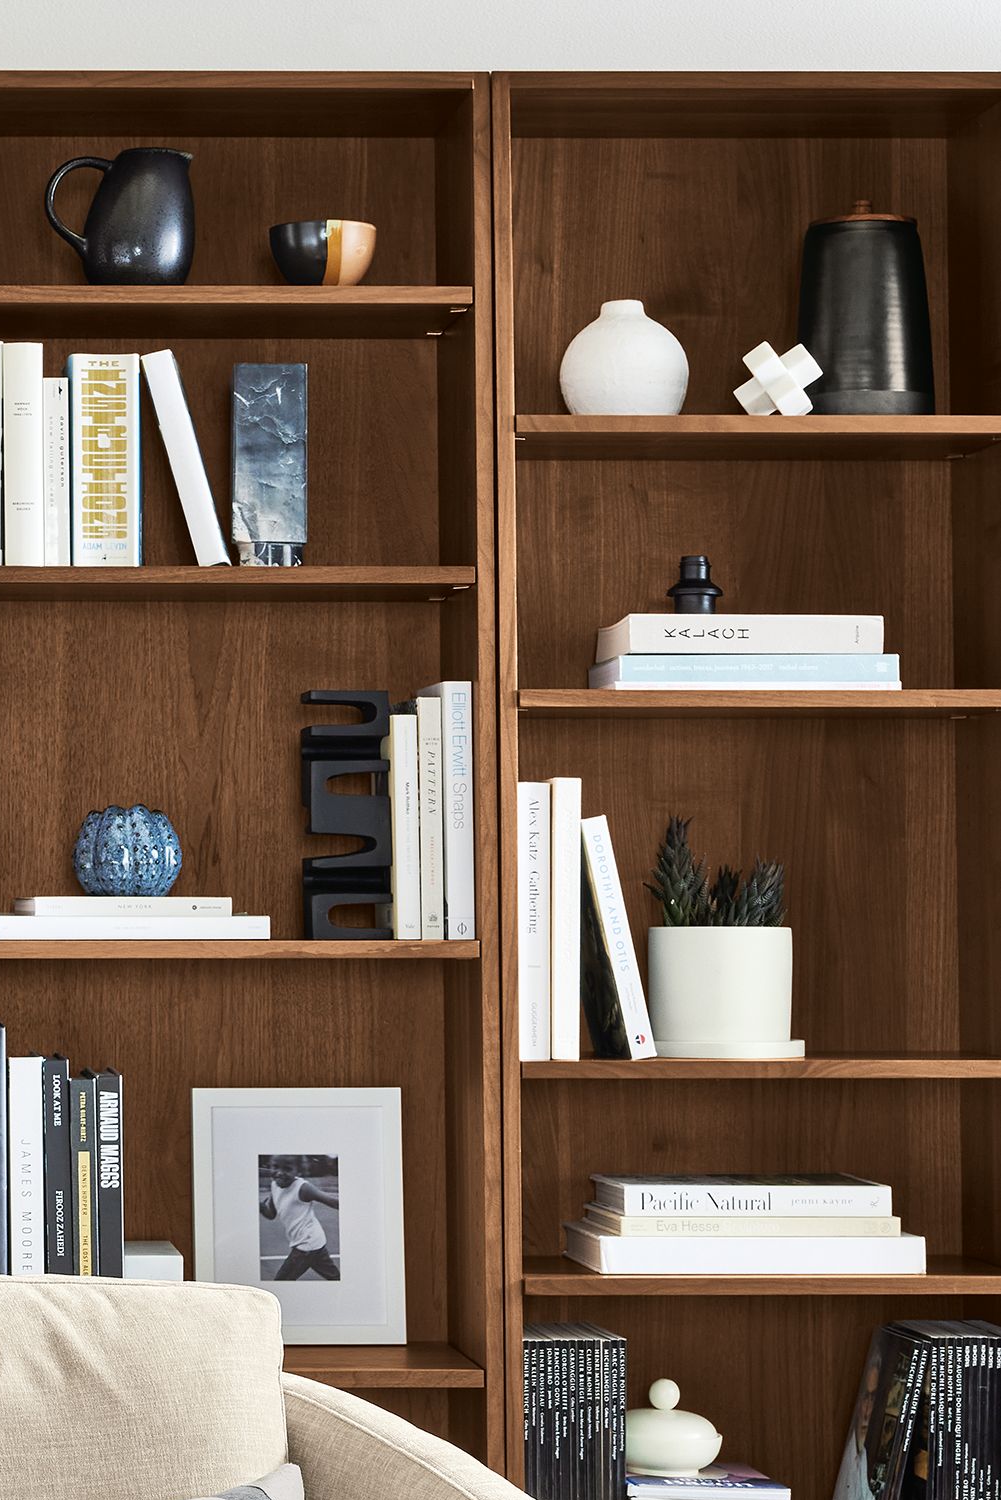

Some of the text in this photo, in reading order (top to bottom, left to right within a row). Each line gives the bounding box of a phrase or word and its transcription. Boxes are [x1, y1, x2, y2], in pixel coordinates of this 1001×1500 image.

[87, 360, 120, 368] THE
[81, 369, 127, 539] INSTRUCTIONS
[663, 627, 750, 639] KALACH
[427, 750, 437, 816] PATTERN
[451, 692, 468, 831] Elliott Erwitt Snaps
[526, 796, 541, 935] Alex Katz Gathering
[592, 834, 631, 973] DOROTHY AND OTIS
[53, 1074, 61, 1126] LOOK AT ME
[99, 1090, 120, 1188] ARNAUD MAGGS
[20, 1139, 33, 1271] JAMES MOORE
[55, 1190, 64, 1257] FIROOZ ZAHEDI
[81, 1164, 89, 1263] DENNIS HOPPER THE LOST
[640, 1191, 772, 1212] Pacific Natural
[656, 1220, 677, 1232] Eva
[682, 1220, 719, 1232] Hesse
[906, 1362, 916, 1387] ESCHER
[910, 1349, 928, 1415] ALEXANDER CALDER
